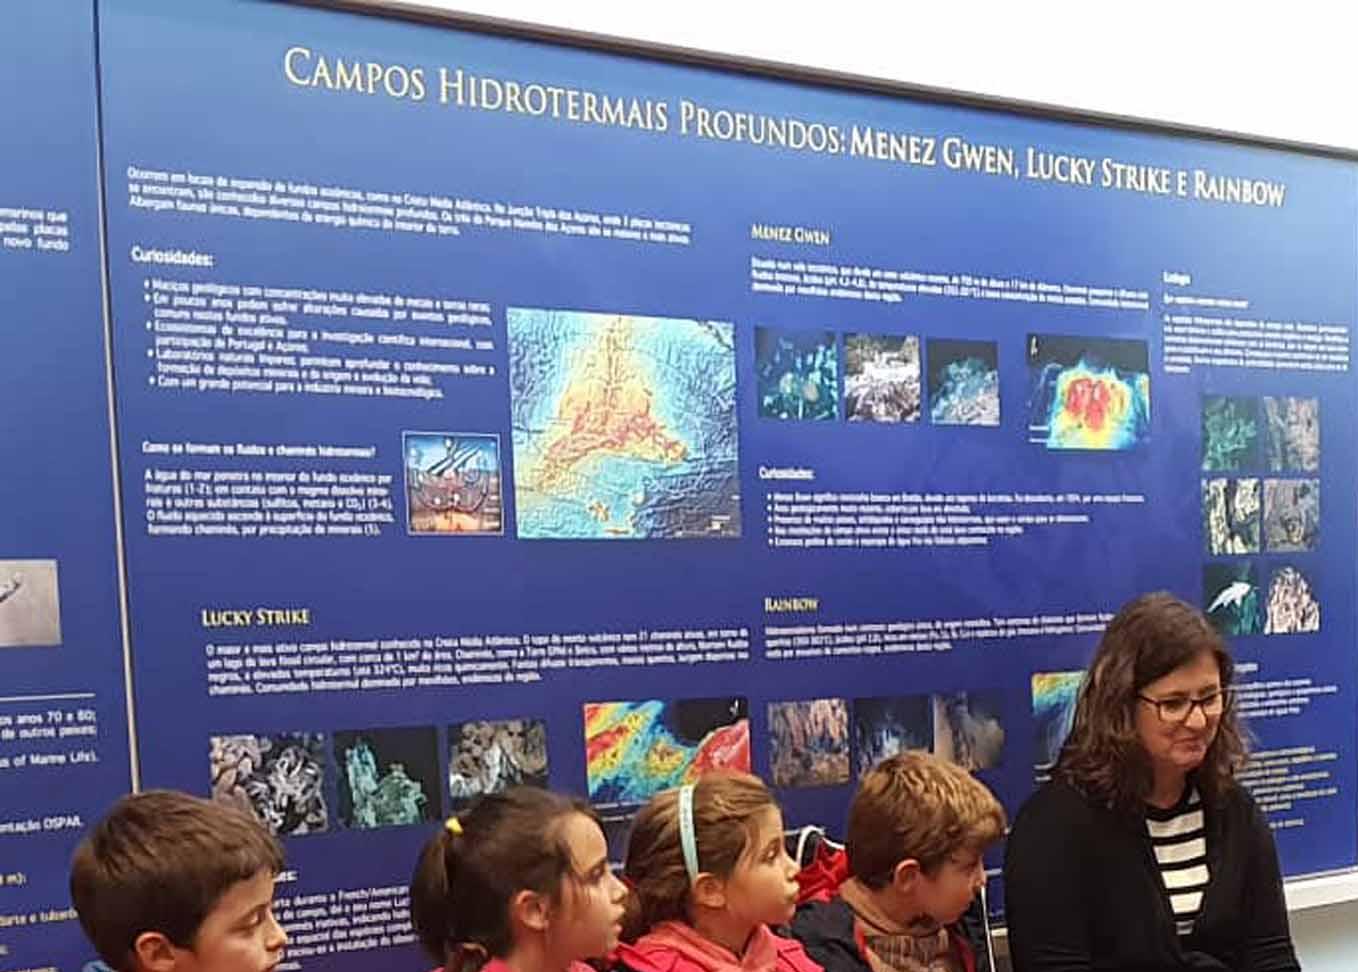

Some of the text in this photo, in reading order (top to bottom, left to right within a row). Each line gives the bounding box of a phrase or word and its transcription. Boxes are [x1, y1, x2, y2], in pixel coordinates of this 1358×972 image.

[284, 47, 1285, 208] CAMPOS HIDROTERMAIS PROFUNDOS: MENEZ GWEN, LUCKY STRIKE E RAINBOW
[202, 608, 310, 627] LUCKY STRIKE
